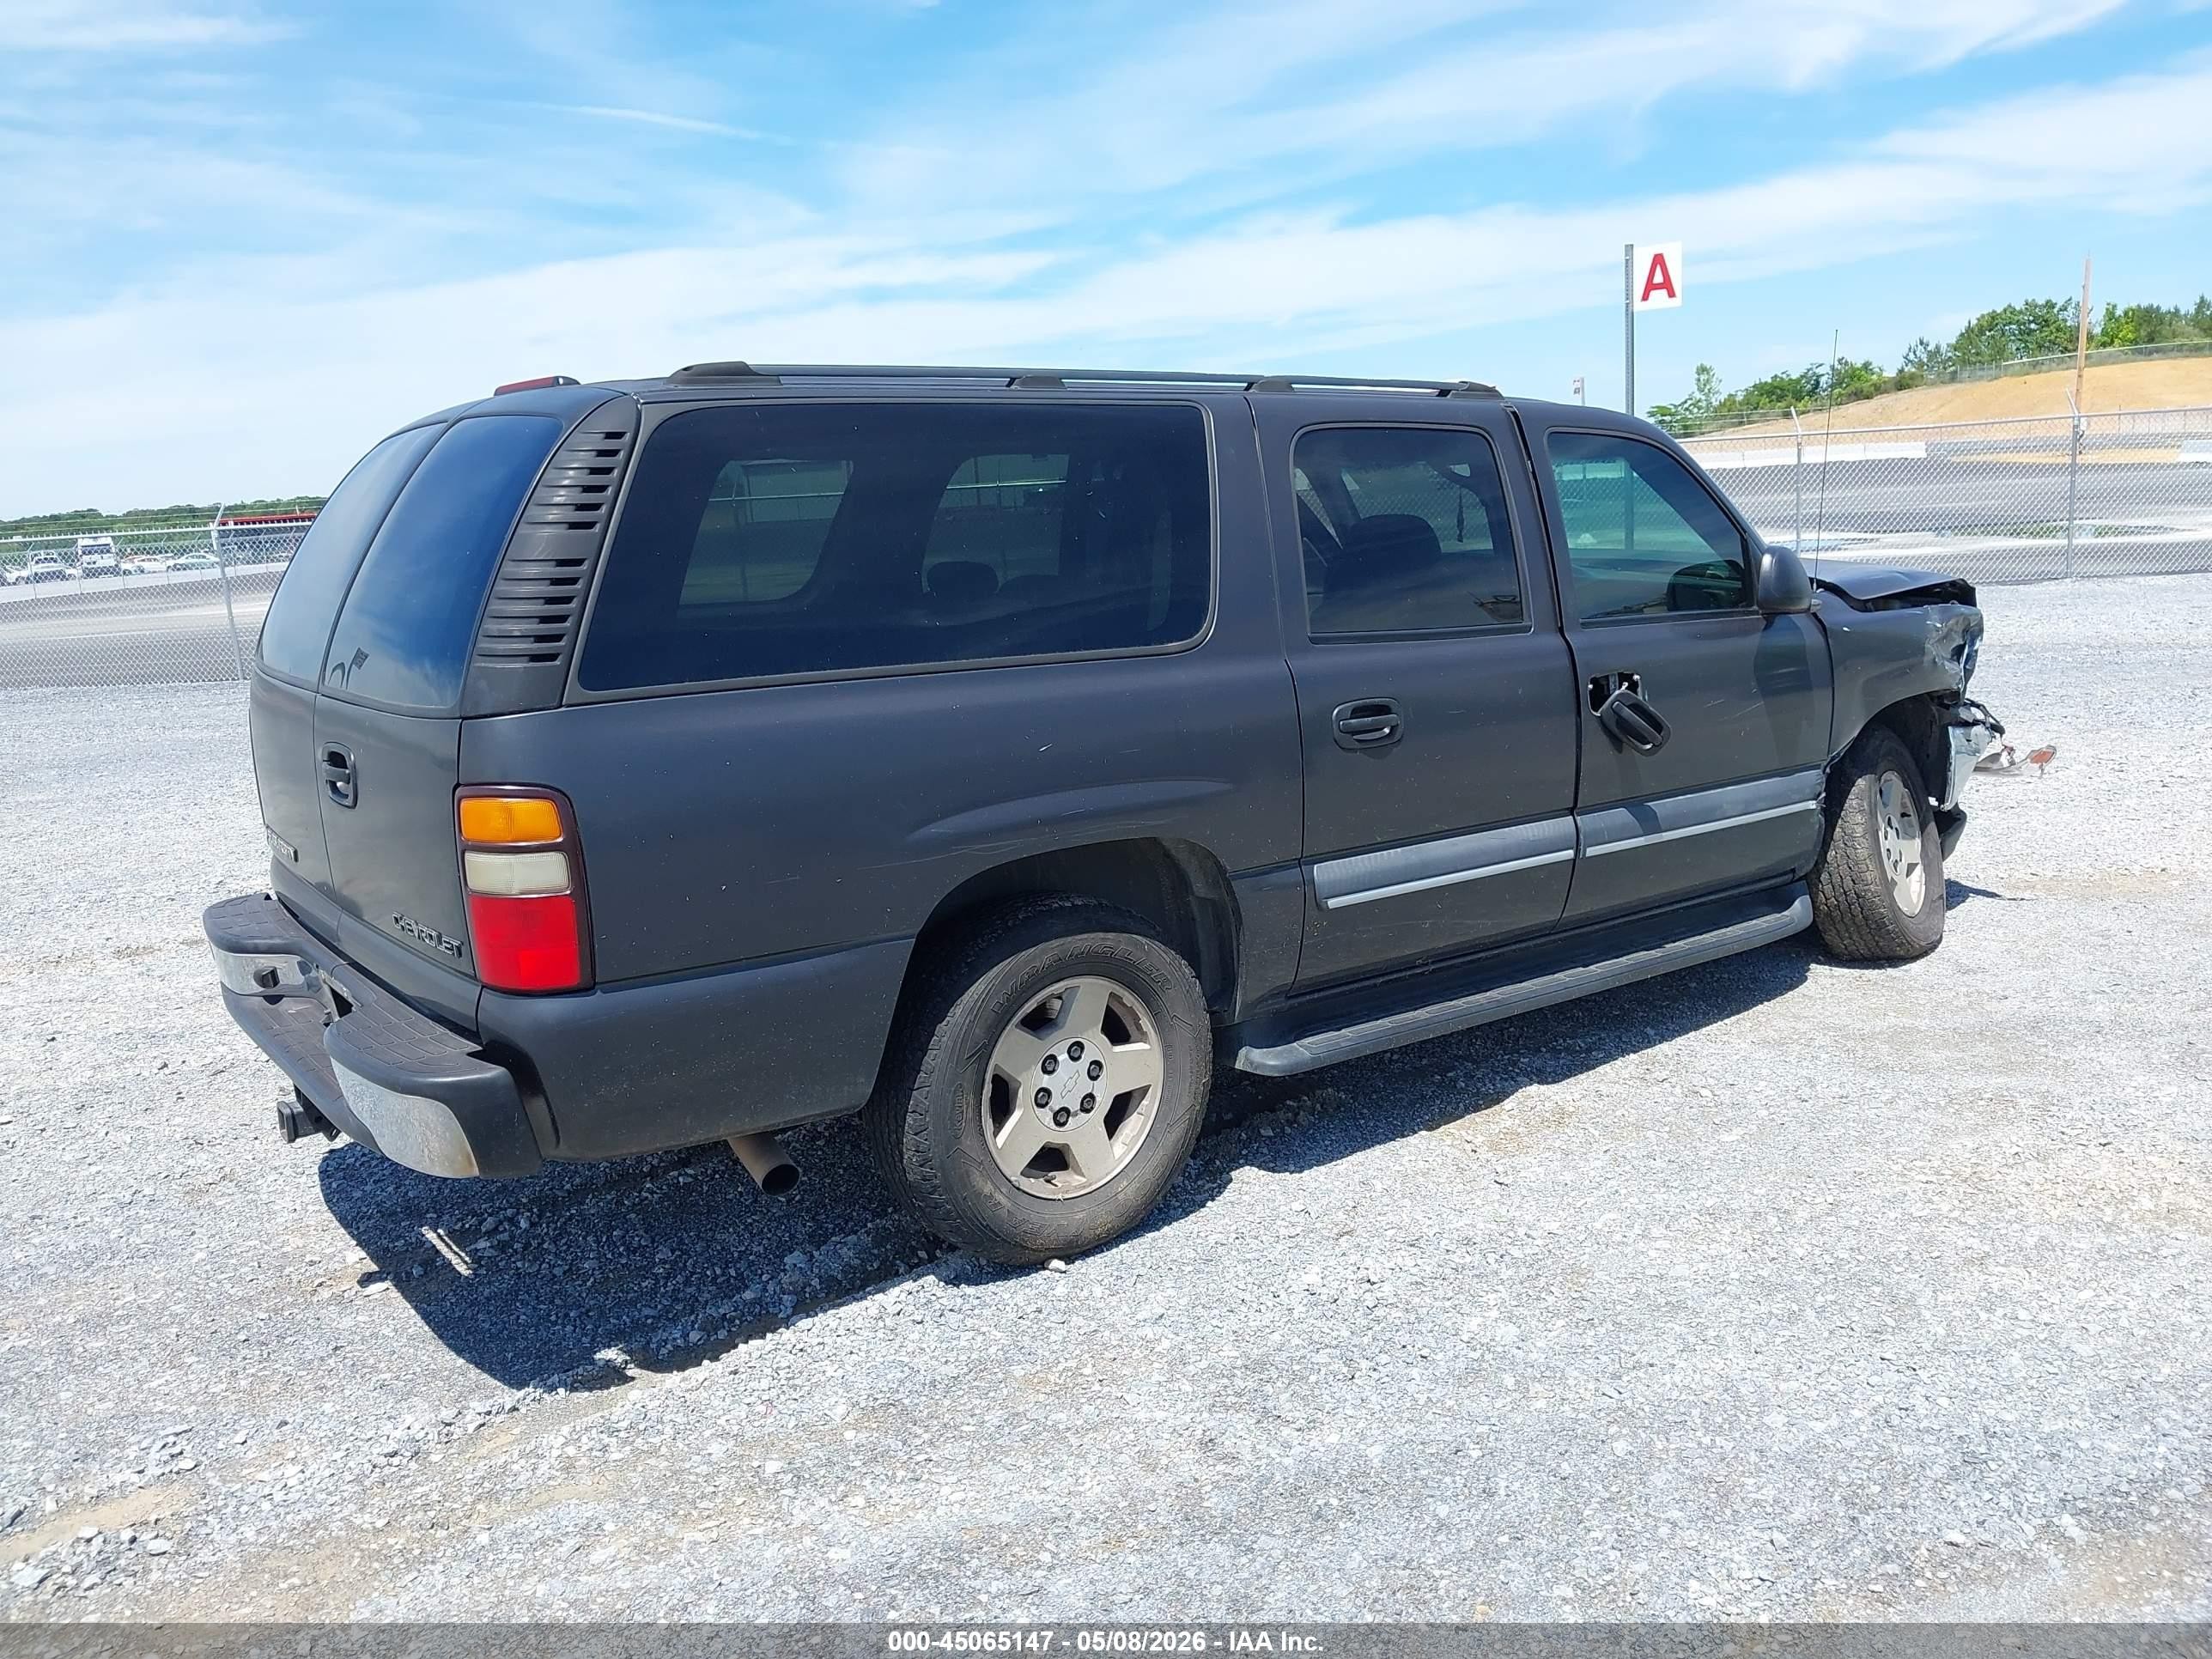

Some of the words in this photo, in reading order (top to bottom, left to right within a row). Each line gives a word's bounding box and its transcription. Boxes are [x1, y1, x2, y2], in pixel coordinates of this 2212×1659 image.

[1641, 252, 1677, 302] A
[392, 911, 463, 958] CHEVROLET
[990, 943, 1174, 1014] WRANGLER
